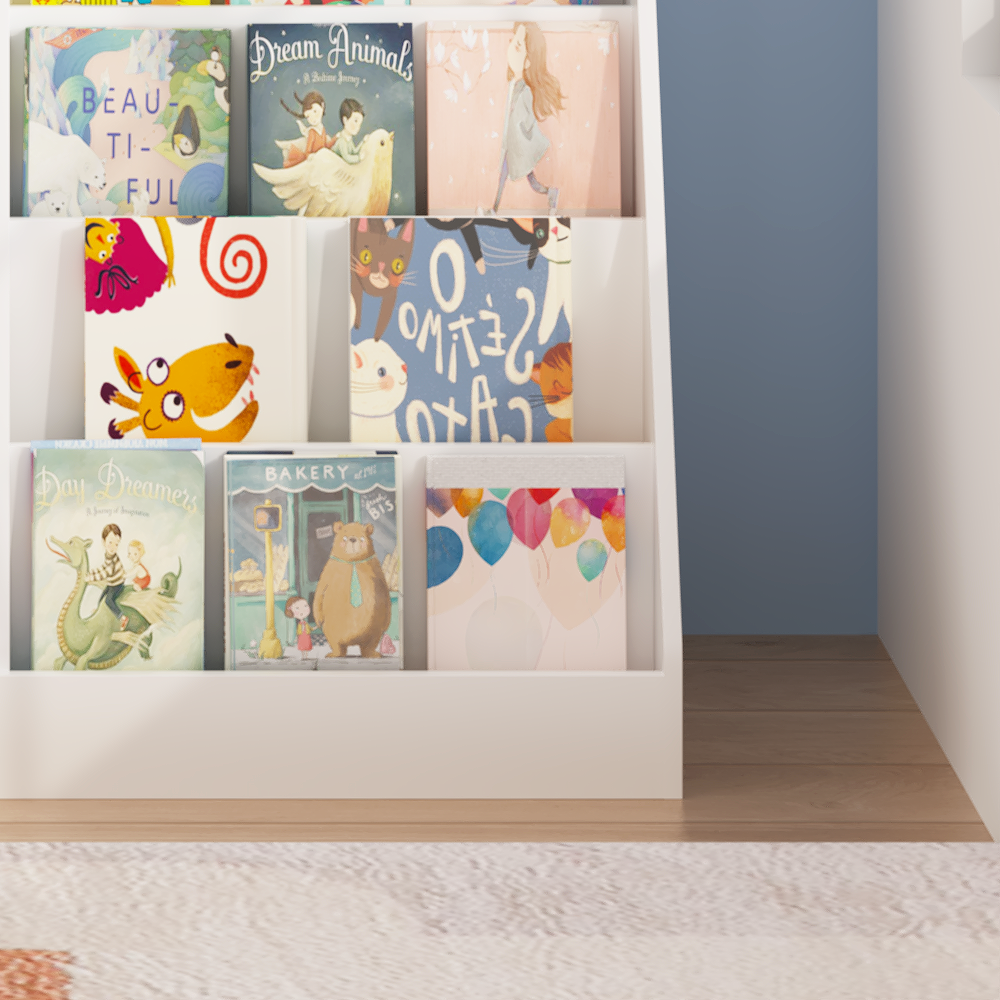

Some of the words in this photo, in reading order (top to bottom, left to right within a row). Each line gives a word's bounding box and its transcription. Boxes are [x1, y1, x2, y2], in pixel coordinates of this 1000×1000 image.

[249, 30, 323, 83] Dream
[327, 22, 413, 82] Animals
[35, 465, 85, 512] Day
[95, 457, 198, 514] Dreamers
[265, 465, 349, 482] BAKERY
[367, 501, 394, 520] BIS
